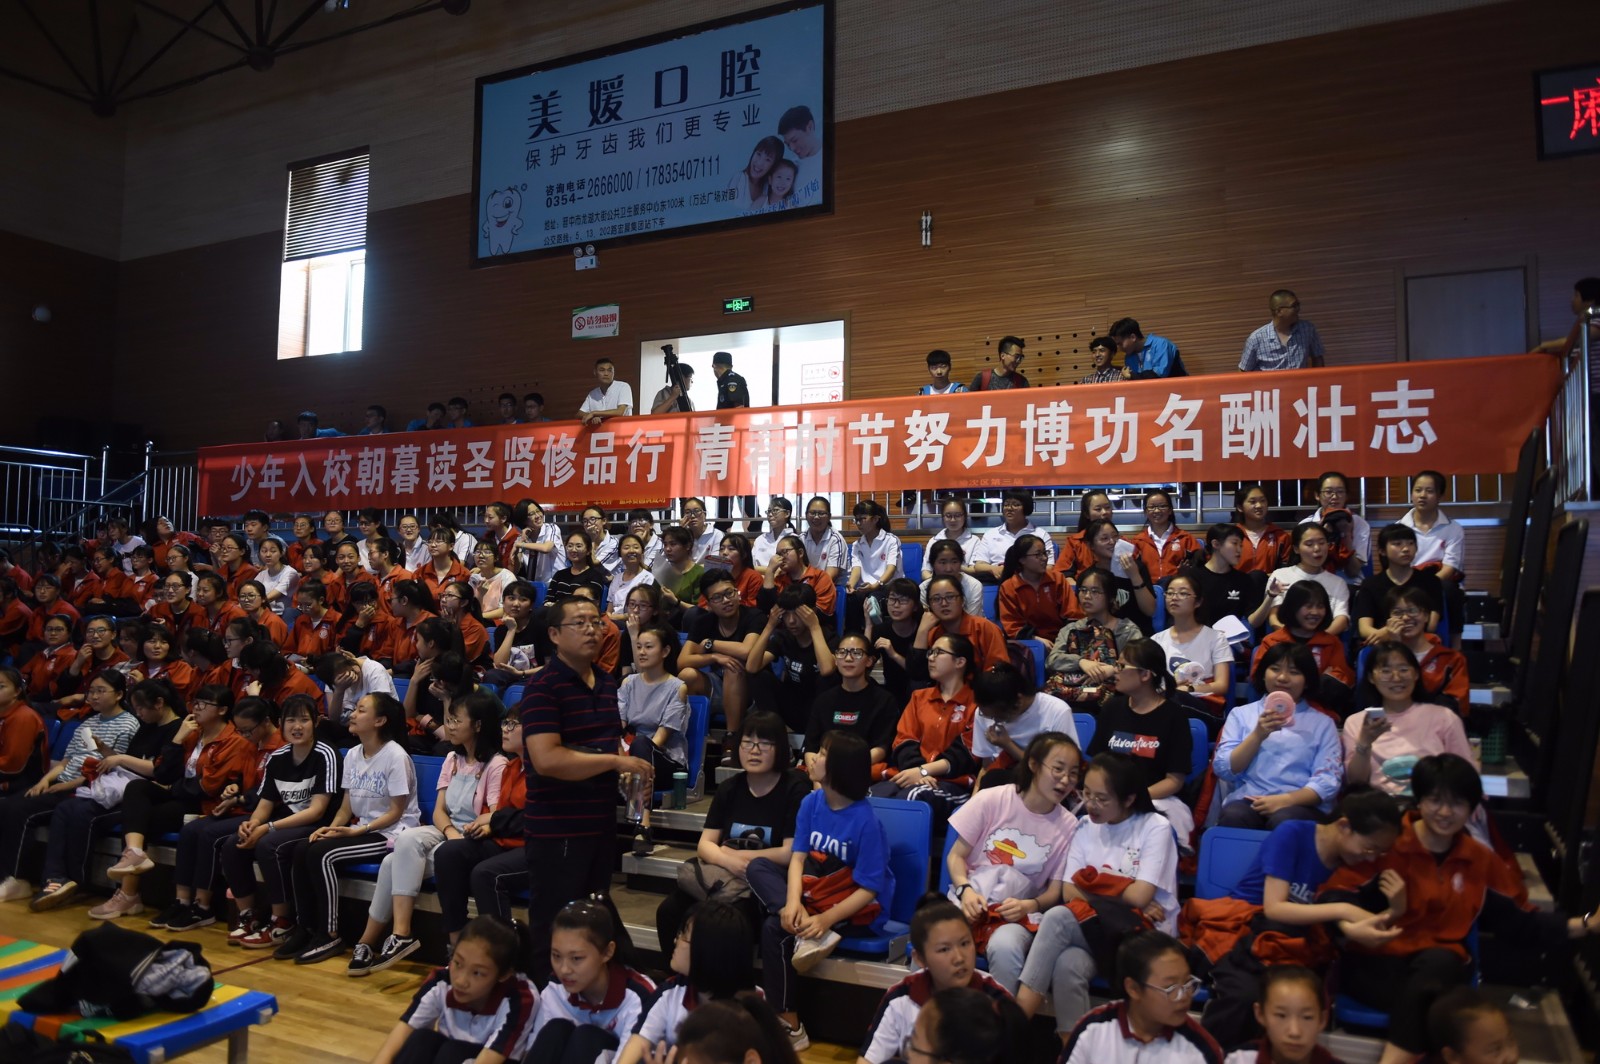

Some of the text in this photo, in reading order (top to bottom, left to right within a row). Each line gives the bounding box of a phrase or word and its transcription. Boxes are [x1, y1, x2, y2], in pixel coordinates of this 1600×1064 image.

[527, 44, 761, 139] 美媛口腔
[525, 104, 761, 171] 保护牙齿我们更专业
[545, 193, 584, 208] 0354-
[587, 170, 633, 198] 2666000
[645, 154, 720, 187] 17835407111
[545, 178, 586, 196] 咨询电话
[586, 313, 617, 325] 请勿吸烟
[231, 379, 1438, 501] 少年入校朝暮读圣贤修品行 青春时节努力博功名酬壮志
